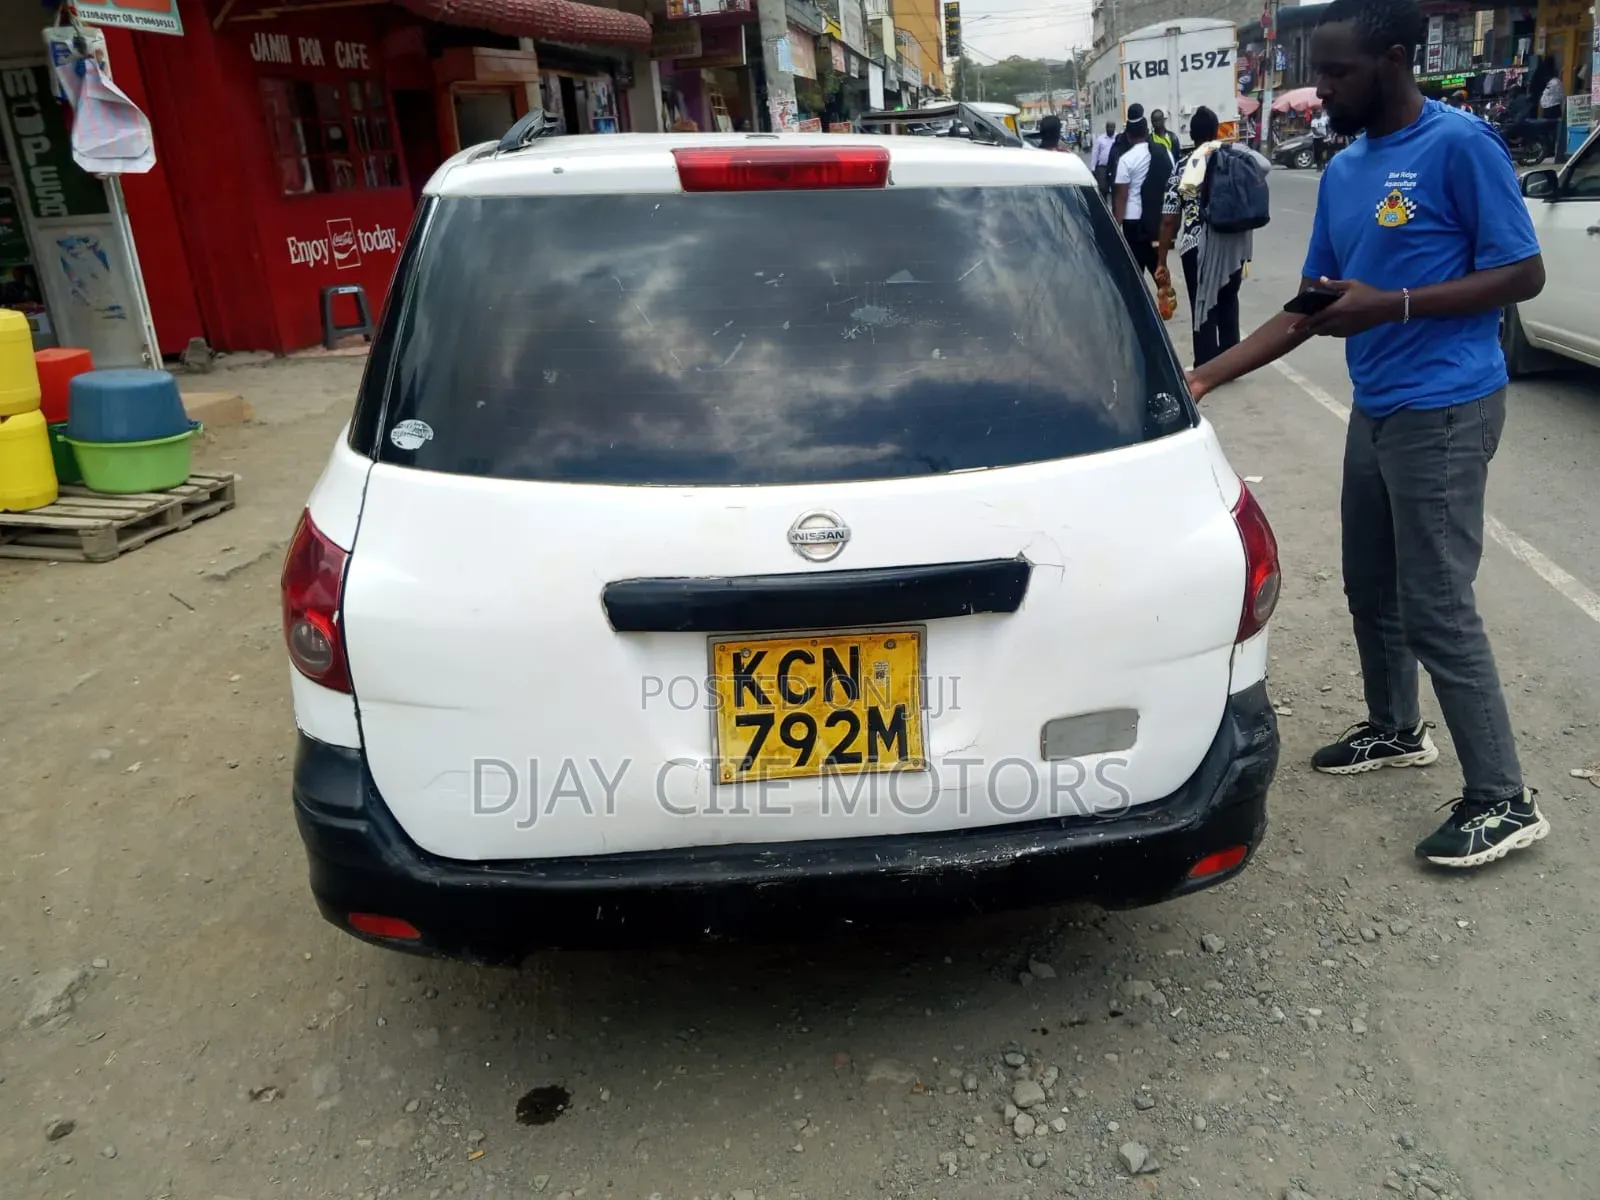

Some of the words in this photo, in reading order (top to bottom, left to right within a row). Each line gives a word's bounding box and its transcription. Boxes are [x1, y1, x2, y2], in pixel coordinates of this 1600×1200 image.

[298, 37, 325, 66] POA
[335, 40, 370, 69] CAFE
[1129, 59, 1169, 80] KBQ
[1180, 49, 1230, 72] 159Z
[287, 236, 329, 268] Enjoy
[357, 223, 401, 253] today.
[792, 531, 845, 541] NISSAN
[732, 645, 861, 708] KCN
[735, 704, 909, 771] 792M
